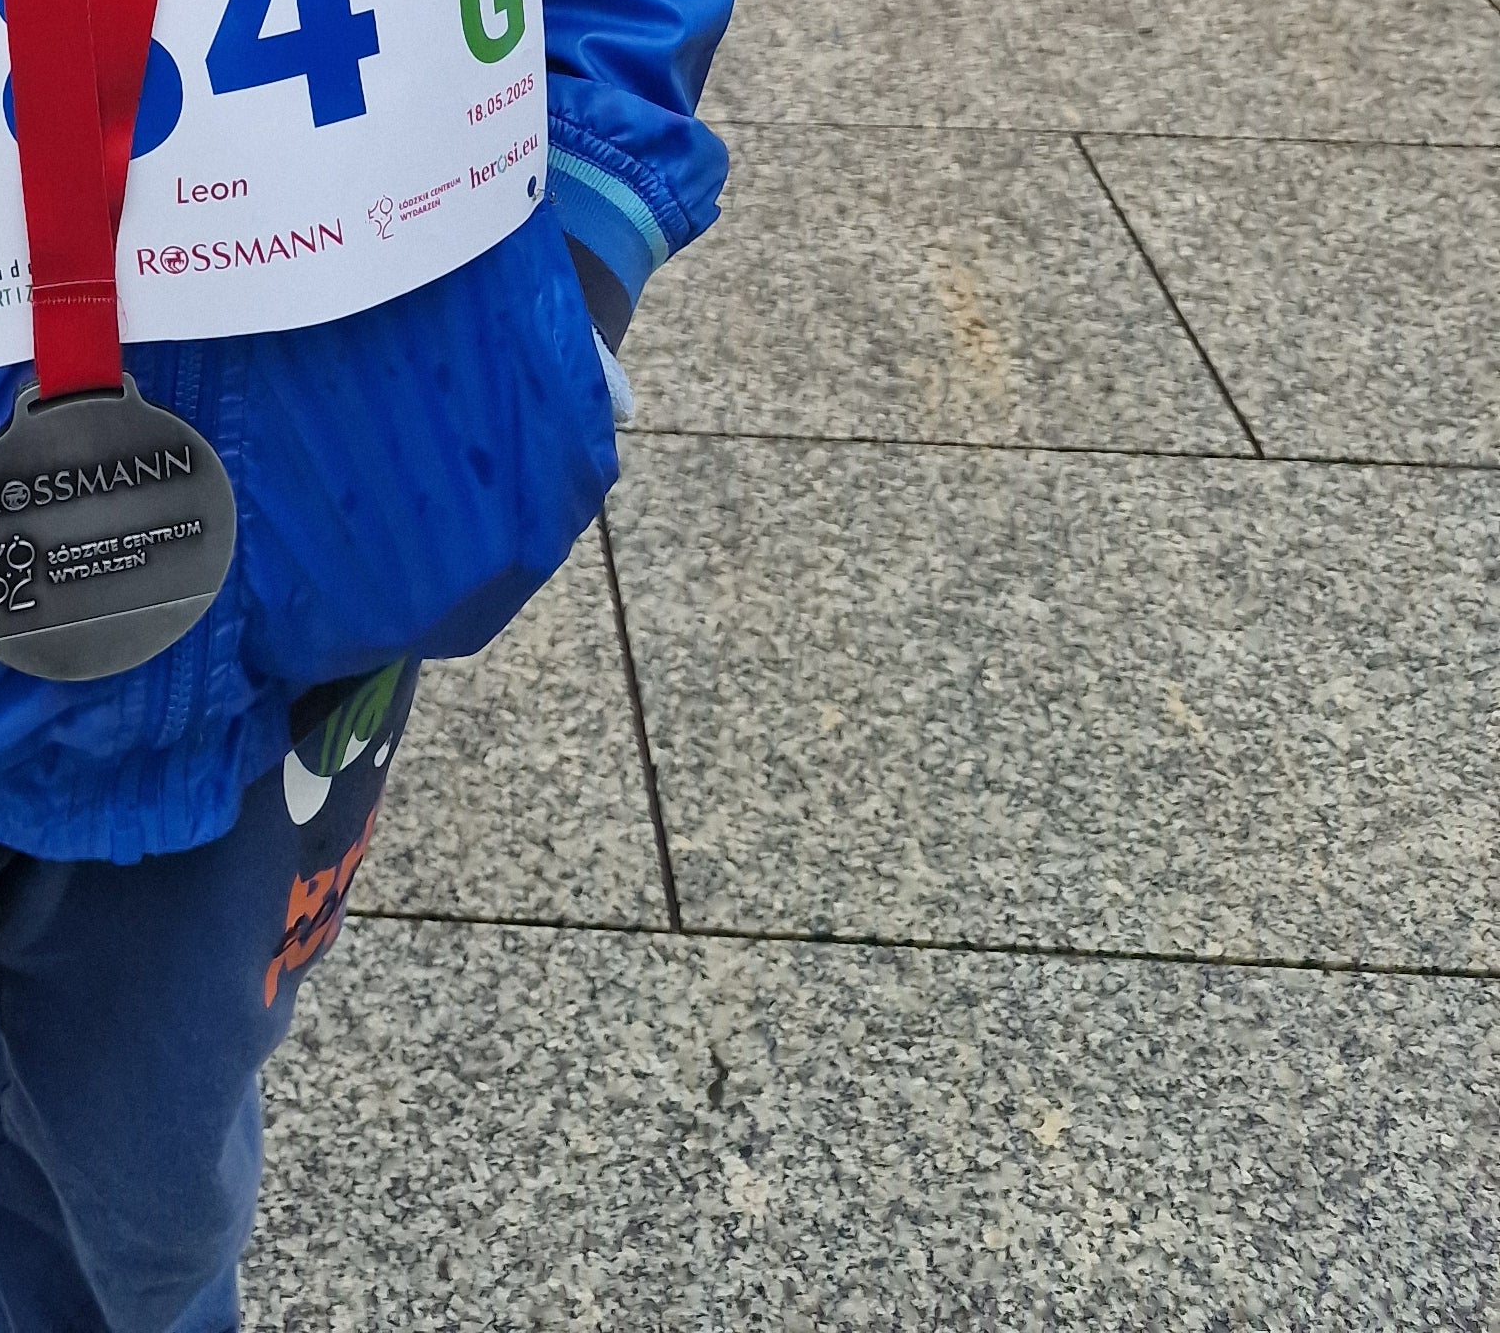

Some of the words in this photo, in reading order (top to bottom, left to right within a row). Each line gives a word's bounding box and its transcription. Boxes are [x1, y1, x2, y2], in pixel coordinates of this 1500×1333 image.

[466, 73, 535, 126] 18.05.2025
[468, 133, 539, 190] herosi.eu
[176, 176, 249, 206] Leon
[136, 218, 345, 277] ROSSMANN
[122, 520, 203, 551] CENTRUM
[48, 550, 147, 584] WYDARZEŃ
